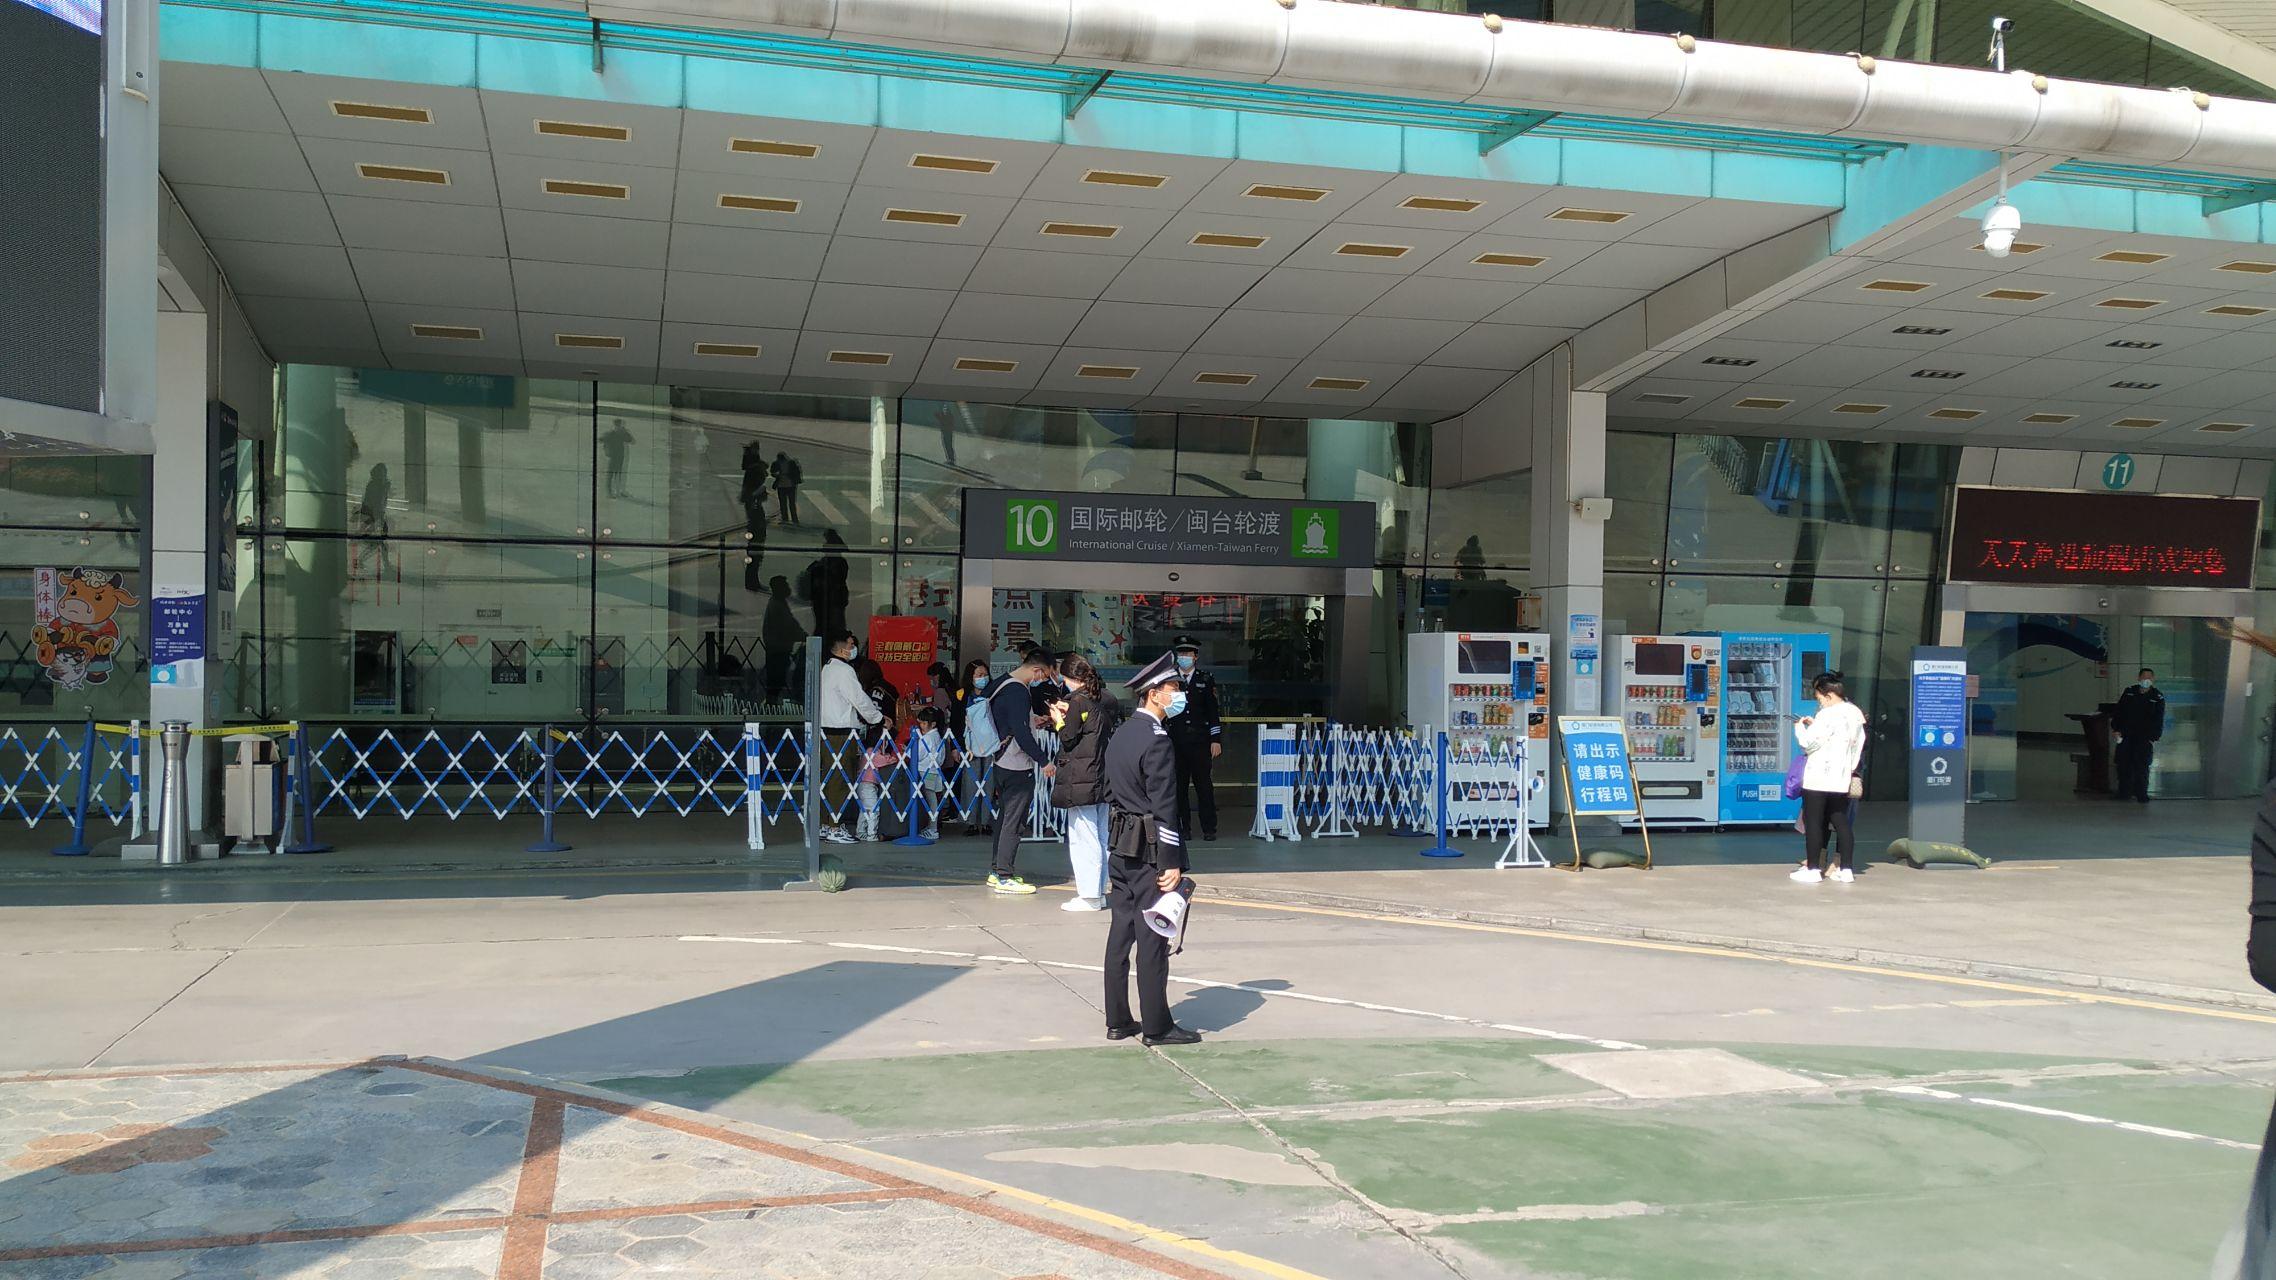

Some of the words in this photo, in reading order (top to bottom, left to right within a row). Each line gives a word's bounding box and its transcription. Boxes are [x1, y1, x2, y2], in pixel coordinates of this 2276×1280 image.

[2107, 459, 2132, 486] 11
[1009, 504, 1054, 548] 10
[1070, 506, 1281, 536] 国际邮轮/闽台轮渡
[1069, 539, 1134, 550] International
[1136, 540, 1168, 551] Cruise
[1177, 541, 1251, 553] Xiamen-Taiwan
[1254, 543, 1280, 555] Ferry
[37, 571, 52, 623] 身体棒
[1573, 743, 1620, 759] 请出示
[1577, 764, 1624, 781] 健康码
[1580, 786, 1628, 804] 行程码
[1742, 790, 1758, 798] PUSH
